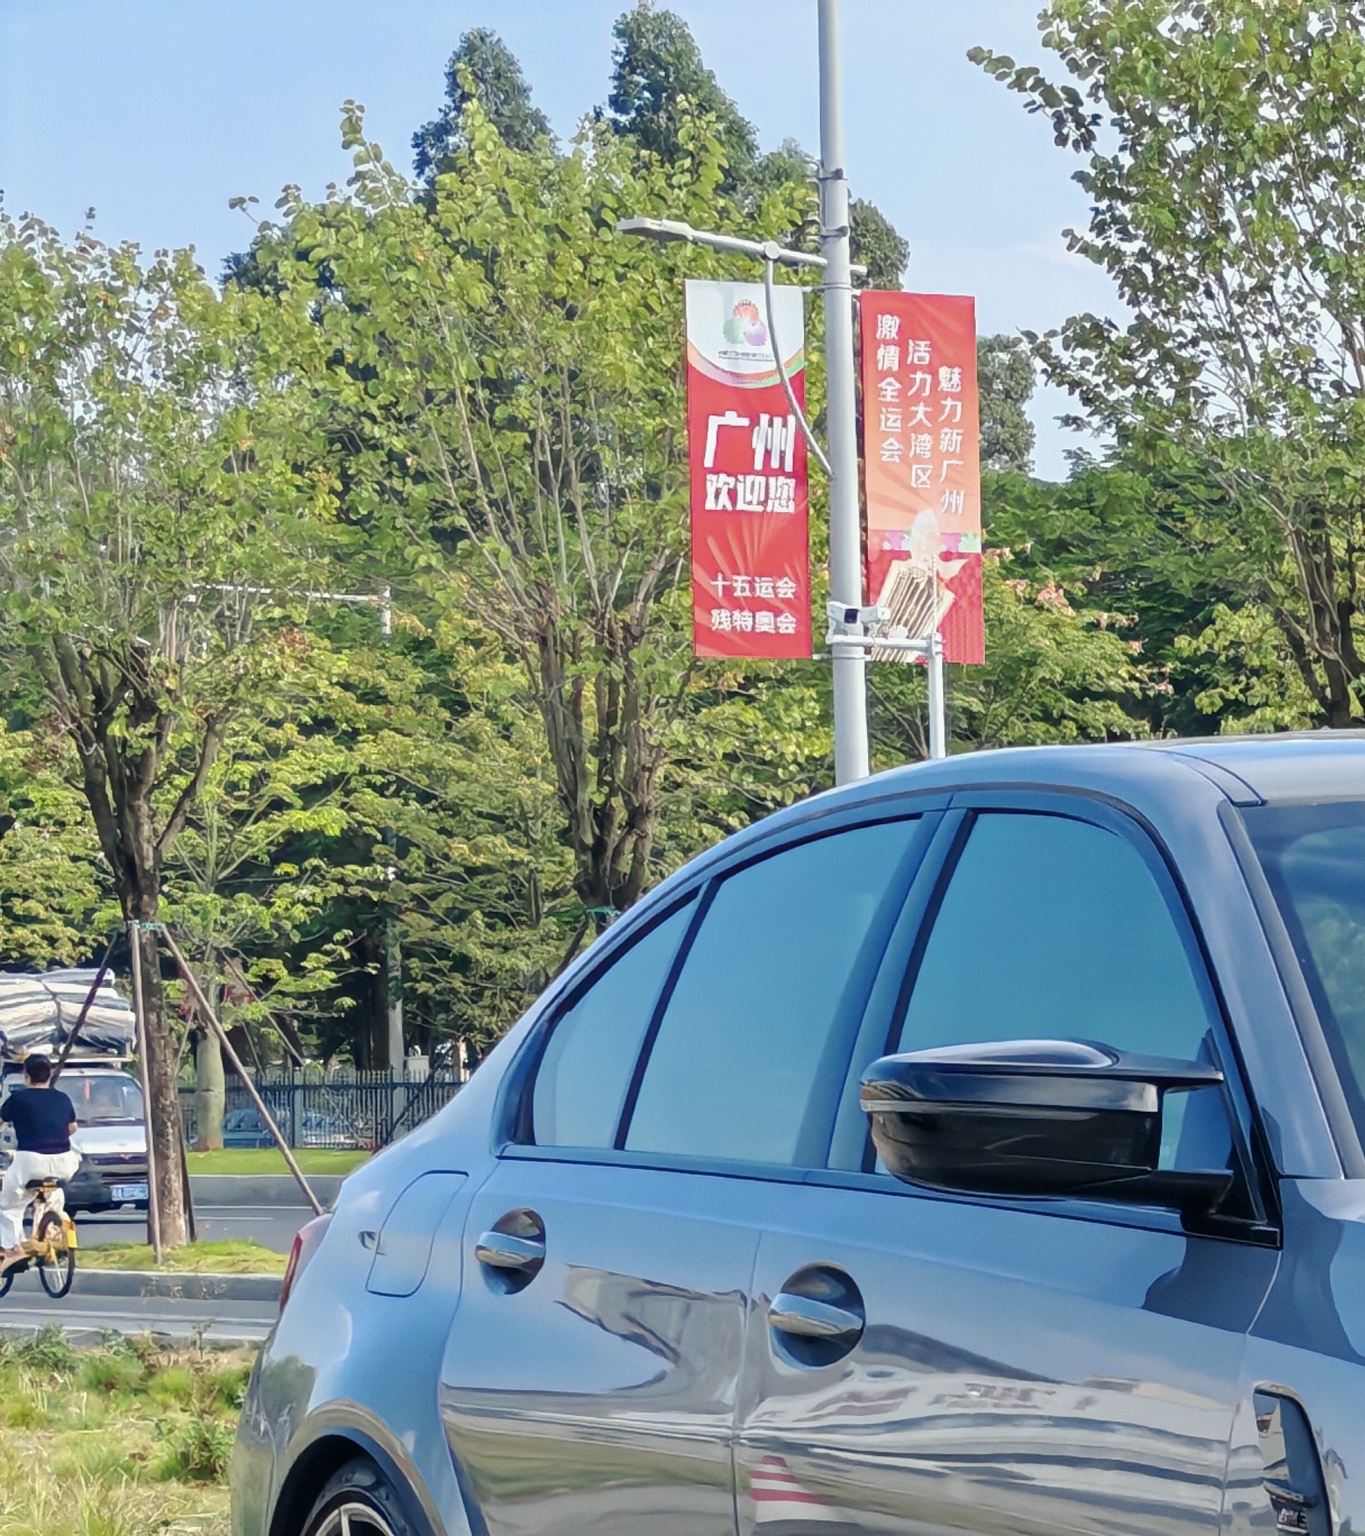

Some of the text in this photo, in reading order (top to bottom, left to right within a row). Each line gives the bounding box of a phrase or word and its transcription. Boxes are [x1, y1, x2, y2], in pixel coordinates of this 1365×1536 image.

[876, 313, 903, 464] 激情全运会
[907, 338, 934, 489] 活力大湾区
[703, 411, 796, 472] 广州
[938, 365, 965, 516] 魅力新广州
[704, 472, 796, 513] 欢迎您
[711, 572, 797, 599] 十五运会
[711, 608, 797, 634] 残特奥会
